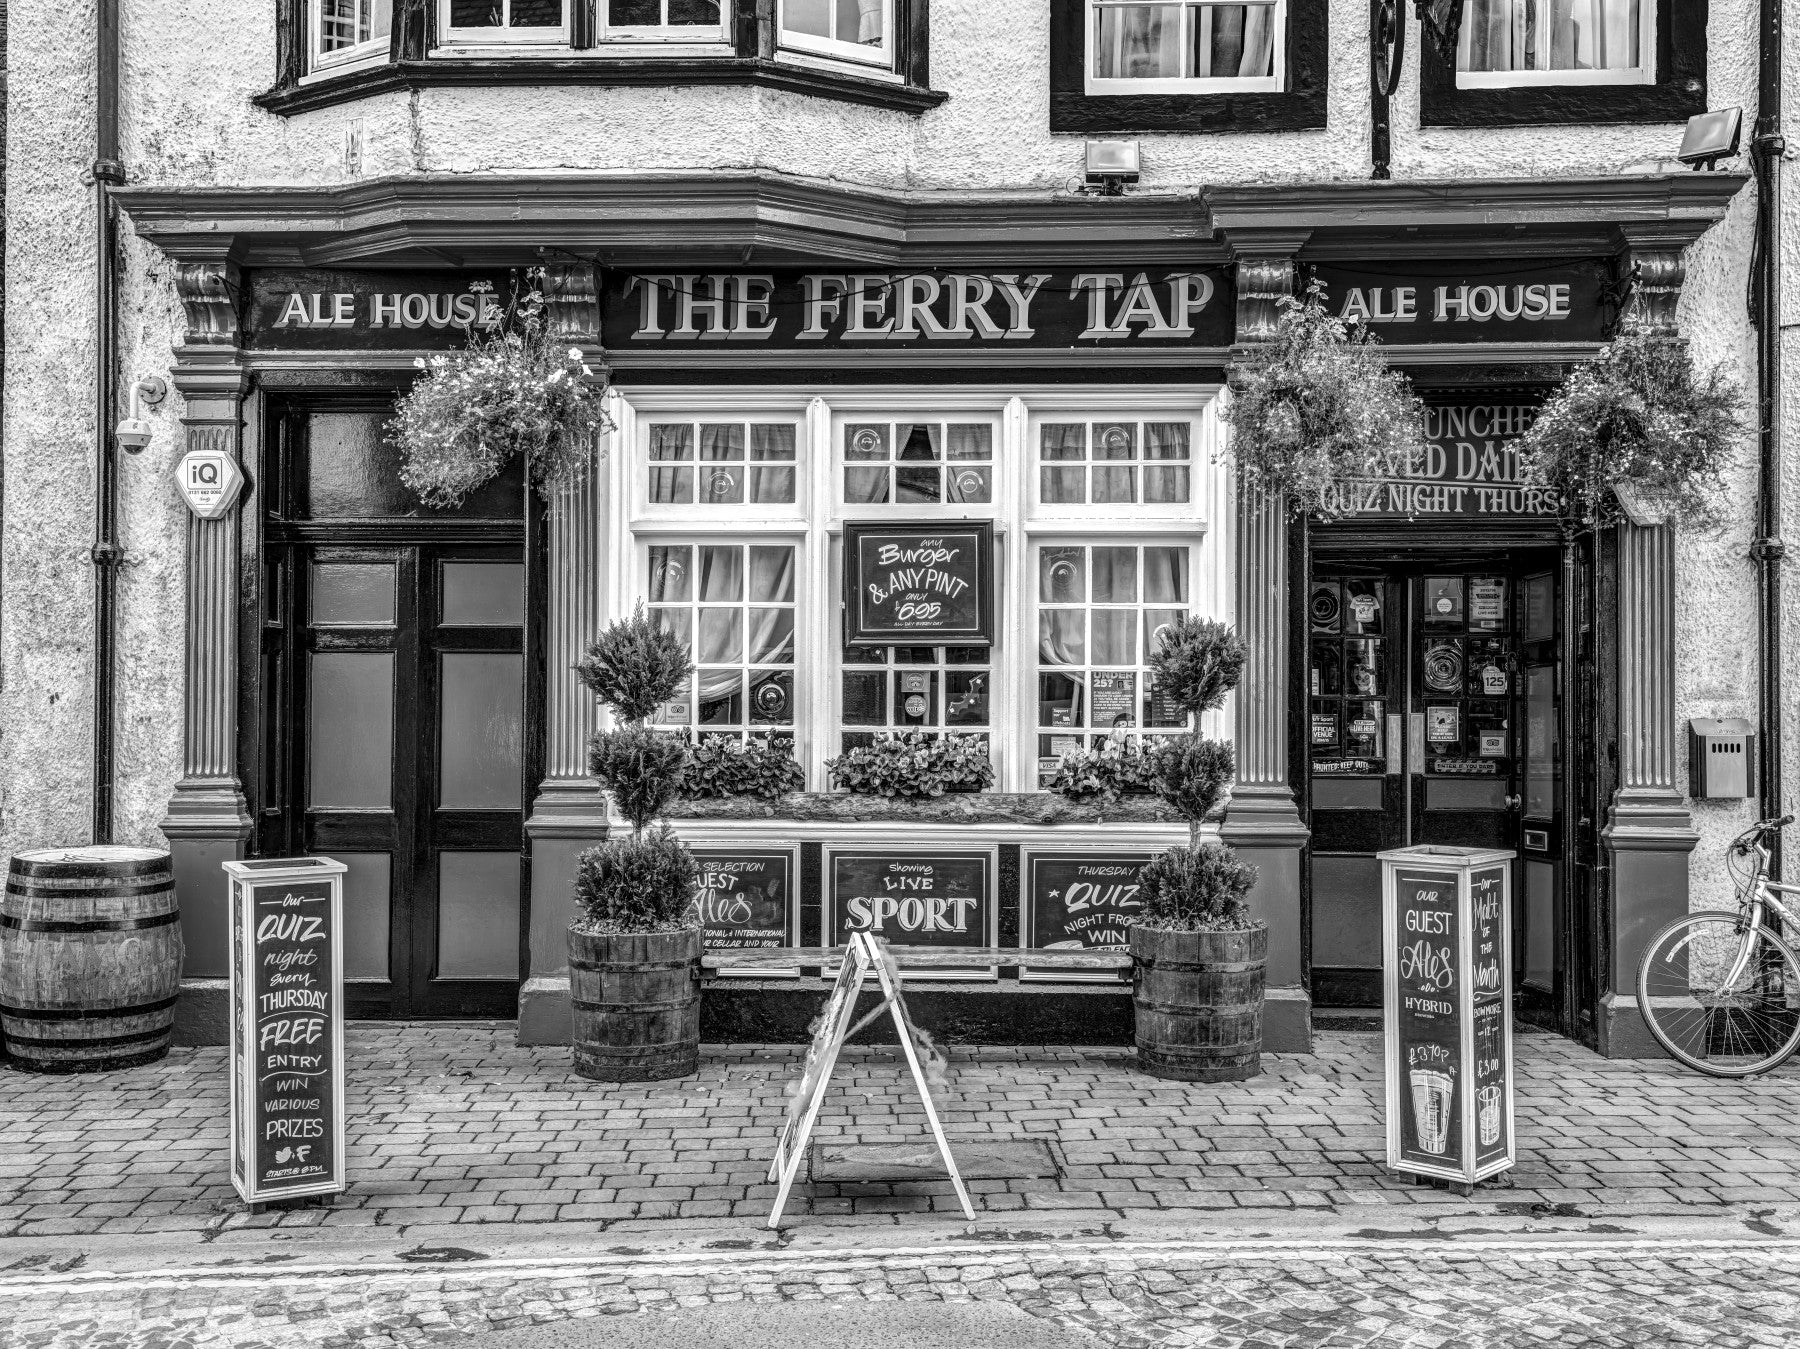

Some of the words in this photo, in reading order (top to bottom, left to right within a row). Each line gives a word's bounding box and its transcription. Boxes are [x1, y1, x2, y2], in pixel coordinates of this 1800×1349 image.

[273, 293, 357, 328] ALE
[370, 293, 500, 328] HOUSE
[622, 273, 777, 340] THE
[796, 273, 1053, 340] FERRY
[1069, 272, 1214, 339] TAP
[1341, 286, 1418, 323] ALE
[1434, 284, 1572, 321] HOUSE
[192, 462, 218, 485] iQ
[1319, 480, 1382, 516] QUIZ
[1387, 483, 1469, 514] NIGHT
[1475, 486, 1560, 515] THURS
[920, 538, 943, 549] any
[878, 543, 960, 567] Burger
[868, 583, 889, 604] &
[889, 568, 926, 595] ANY
[925, 568, 969, 599] PINT
[905, 592, 929, 601] ONLY
[1093, 671, 1134, 679] UNDER
[1093, 679, 1113, 688] 25?
[1486, 676, 1504, 687] 125
[1363, 724, 1376, 732] HERE
[702, 861, 766, 872] SELECTION
[1078, 866, 1136, 876] THURSDAY
[883, 876, 934, 891] LIVE
[1064, 882, 1141, 914] QUIZ
[1416, 890, 1439, 902] OUR
[844, 896, 978, 933] SPORT
[1472, 892, 1499, 931] Malt
[256, 913, 327, 944] QUIZ
[1063, 913, 1105, 935] NIGHT
[1405, 909, 1453, 935] GUEST
[704, 928, 728, 938] IONAL
[734, 928, 787, 938] INTERNATIONAL
[1087, 930, 1126, 943] WIN
[1482, 926, 1491, 938] OF
[712, 939, 742, 948] CELLAR
[743, 939, 760, 948] AND
[760, 939, 780, 949] YOUR
[1480, 941, 1493, 955] THE
[264, 949, 318, 971] night
[1400, 939, 1455, 988] Ales
[1473, 958, 1500, 990] Month
[259, 989, 328, 1013] THURSDAY
[1405, 996, 1453, 1015] HYBRID
[1473, 1002, 1502, 1019] BOWMORE
[259, 1018, 325, 1051] FREE
[267, 1054, 322, 1069] ENTRY
[276, 1077, 309, 1092] WIN
[264, 1098, 321, 1113] VARIOUS
[266, 1118, 324, 1141] PRIZES
